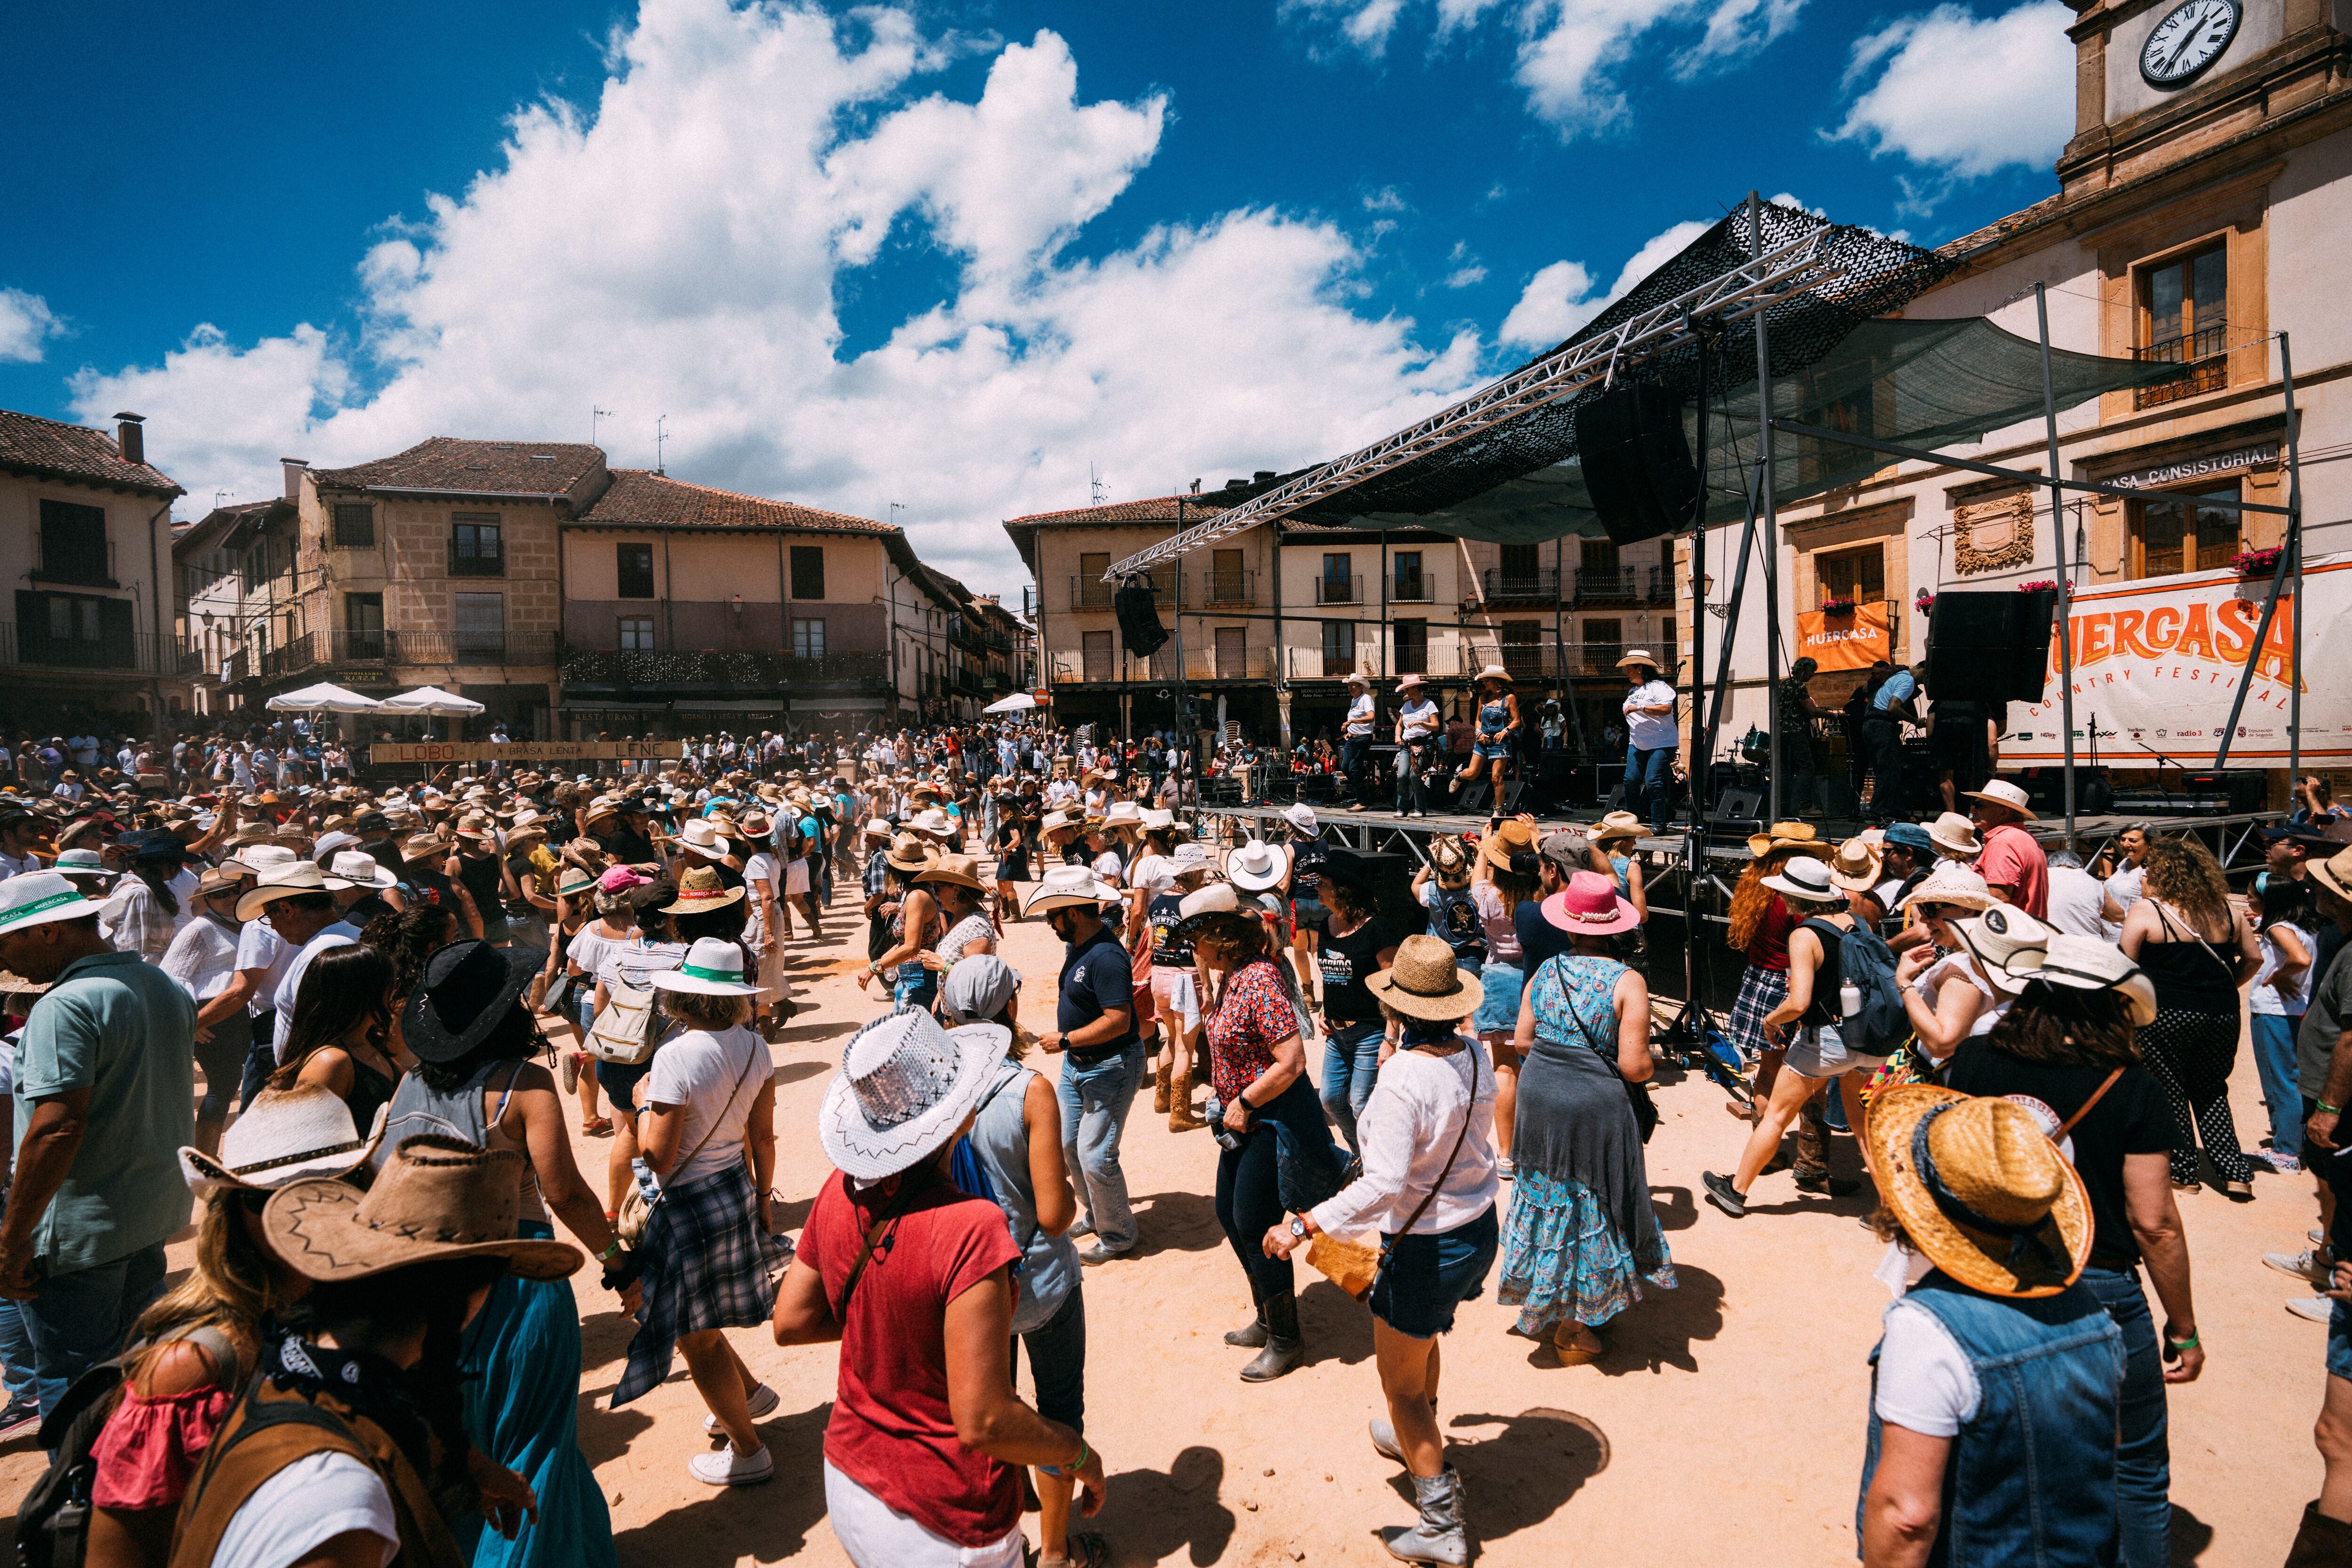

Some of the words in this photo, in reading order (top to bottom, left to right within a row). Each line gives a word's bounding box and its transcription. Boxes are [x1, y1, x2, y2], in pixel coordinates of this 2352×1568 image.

[2149, 447, 2273, 484] CONSISTORIAL
[1807, 627, 1878, 647] HUERCASA
[2045, 594, 2308, 693] UERCASA
[400, 745, 455, 761] LOBO
[497, 747, 503, 756] A
[509, 747, 543, 756] BRASA
[549, 746, 583, 756] LENTA
[1299, 858, 1325, 868] COUNTR
[35, 896, 69, 910] HUERCASA
